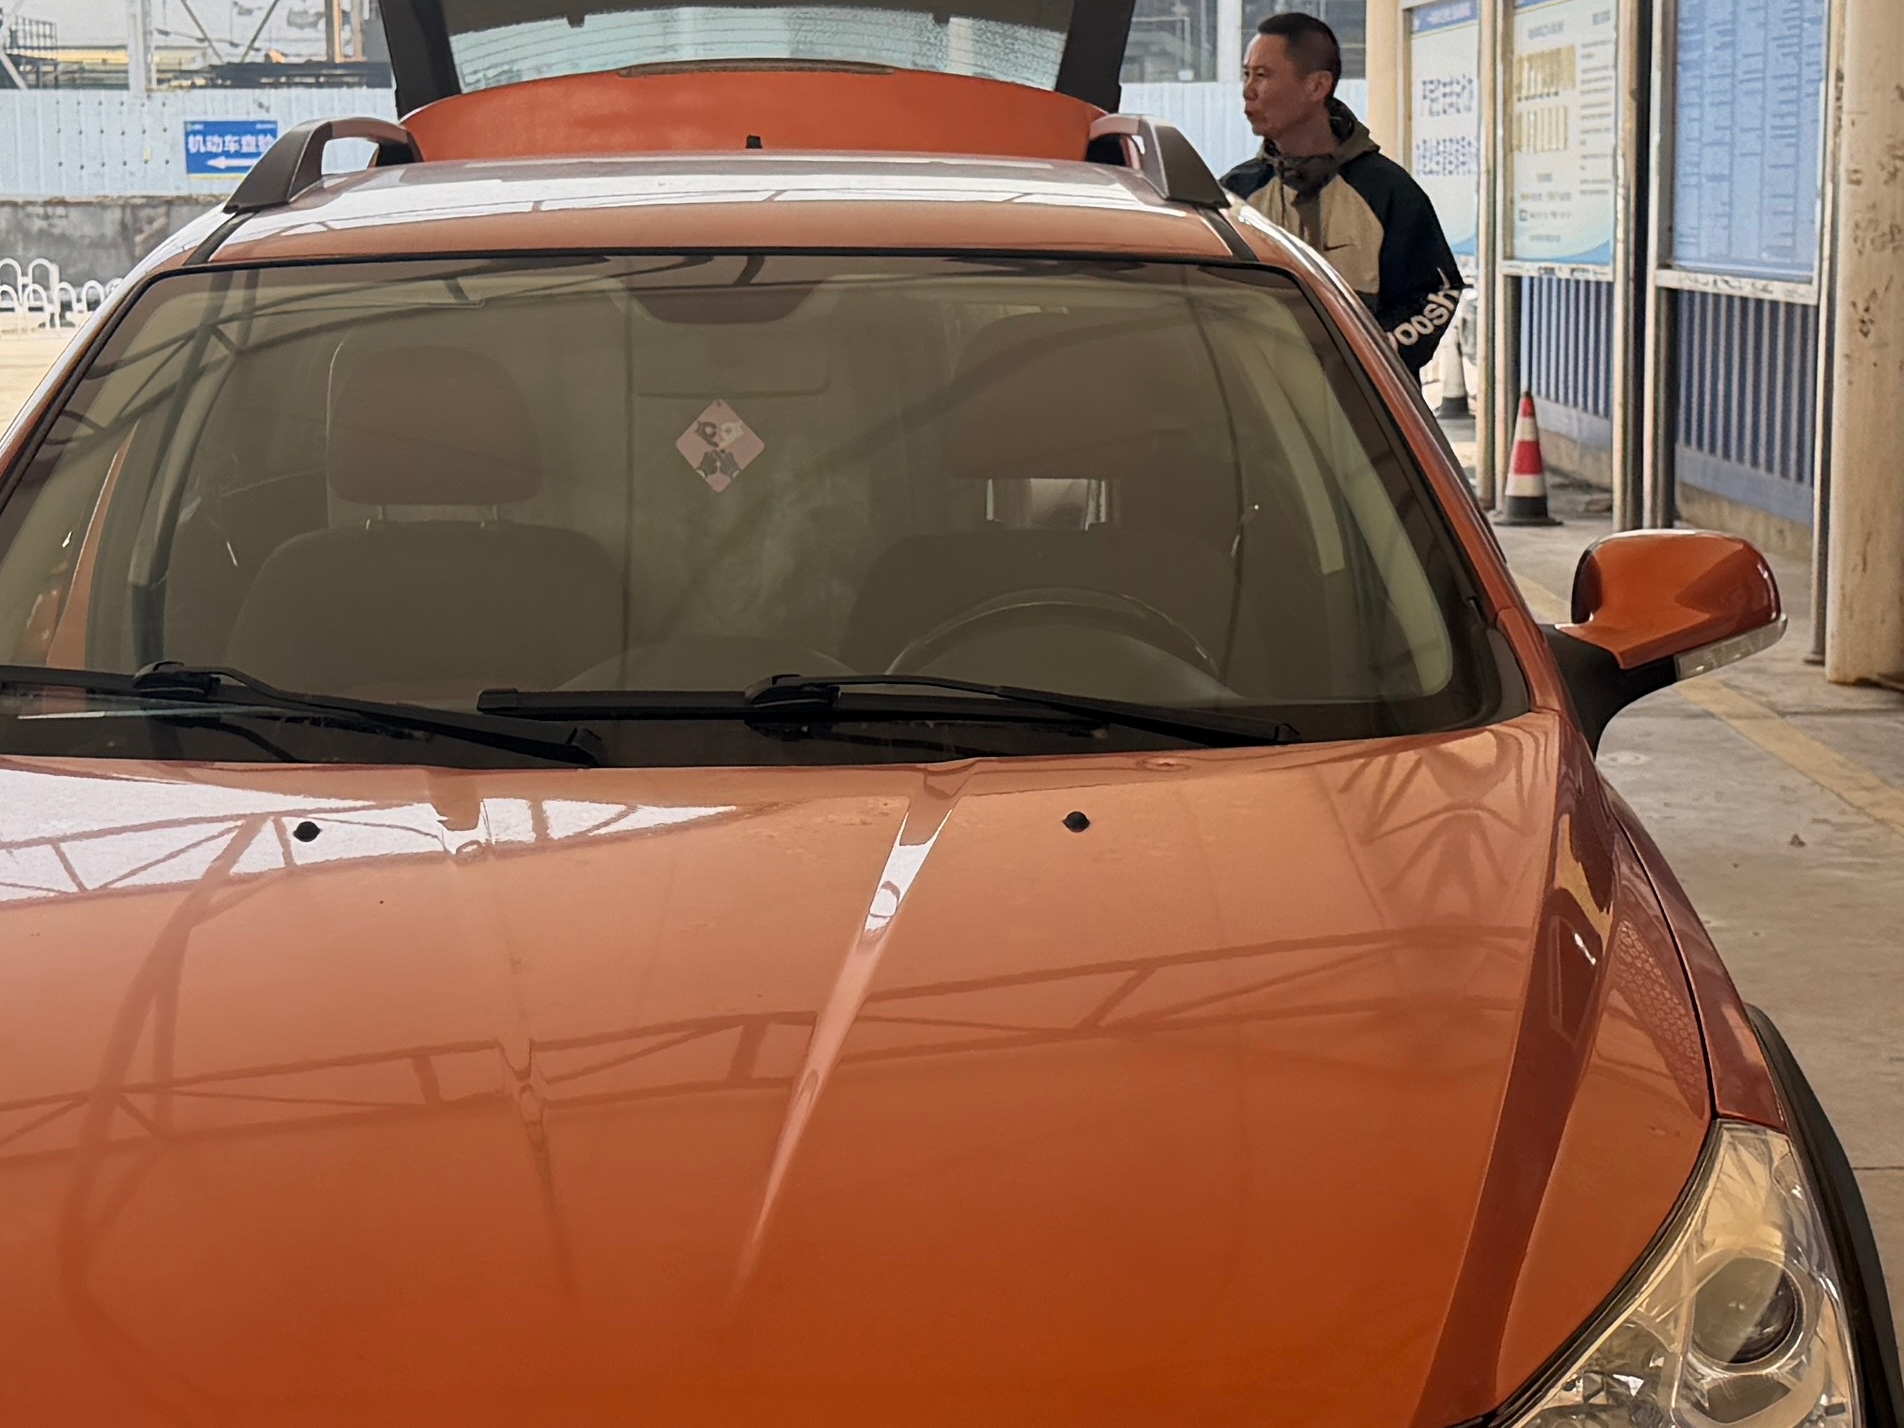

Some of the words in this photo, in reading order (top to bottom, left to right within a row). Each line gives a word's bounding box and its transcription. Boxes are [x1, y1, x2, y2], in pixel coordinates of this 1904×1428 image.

[188, 133, 273, 153] 机动车查验
[1386, 290, 1462, 350] oosh
